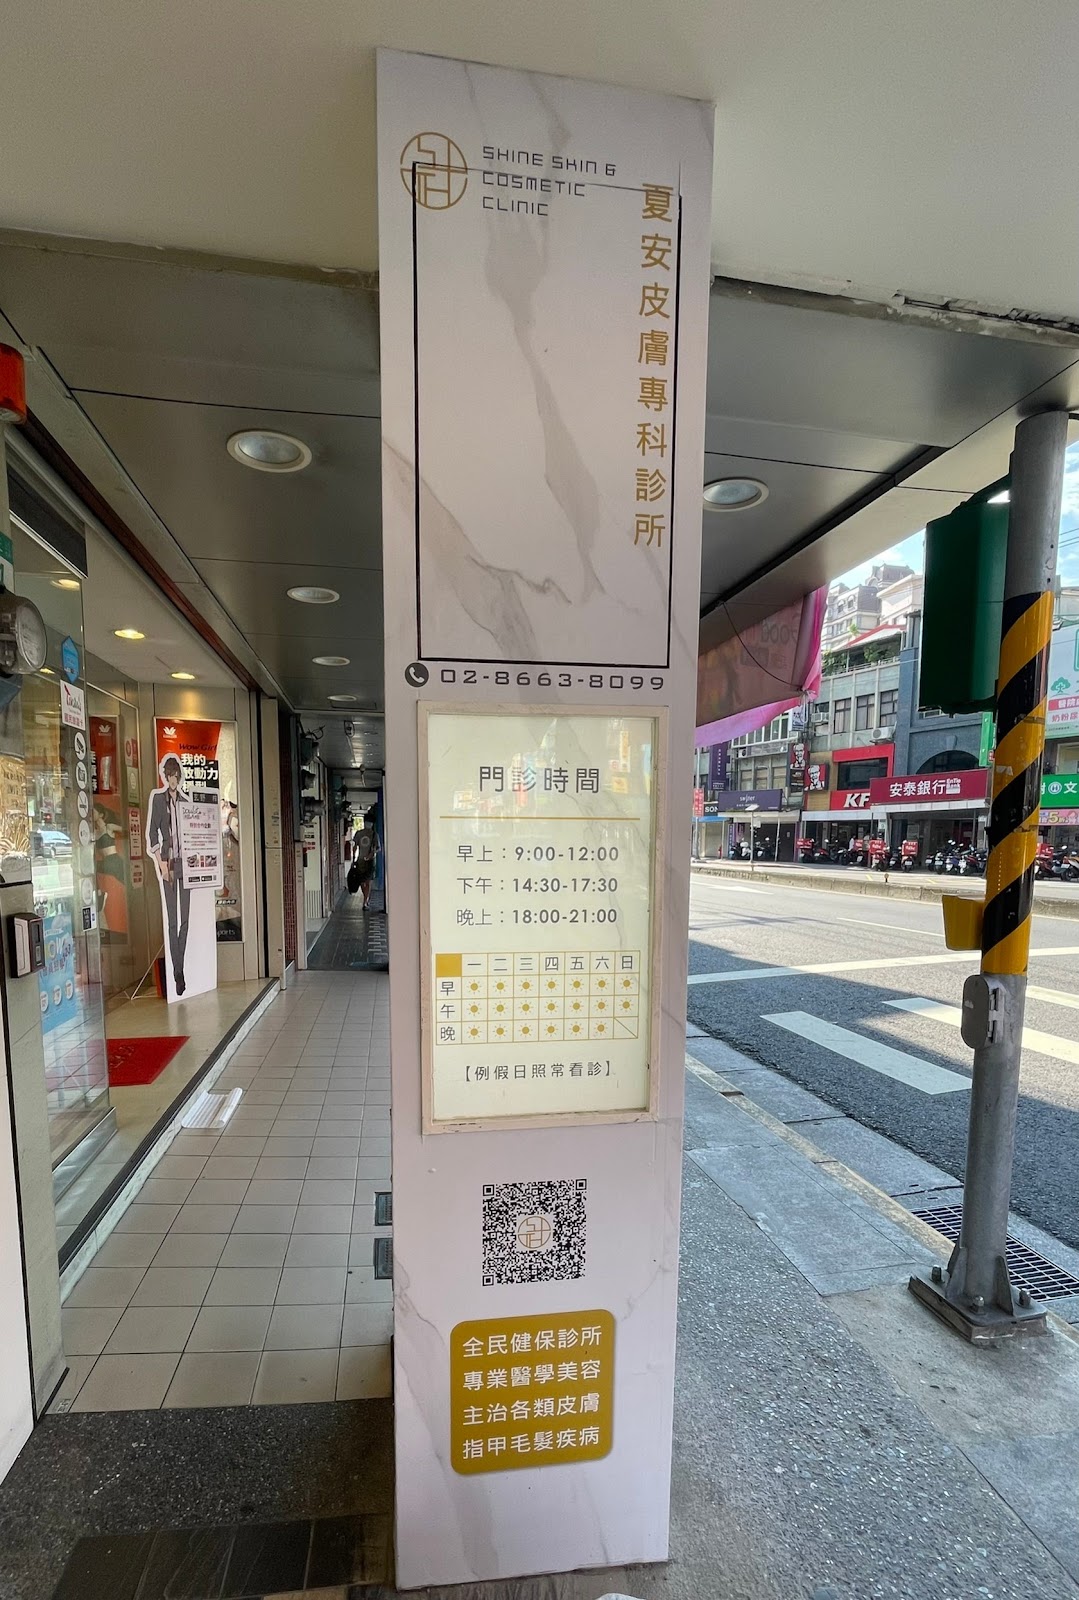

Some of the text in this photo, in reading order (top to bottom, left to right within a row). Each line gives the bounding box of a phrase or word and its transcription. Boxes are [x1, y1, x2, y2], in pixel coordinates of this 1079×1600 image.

[482, 145, 544, 167] SHINE
[551, 155, 597, 175] SKIN
[482, 170, 586, 197] COSMETIC
[482, 196, 549, 217] CLINIC
[632, 182, 675, 549] 夏安皮膚專科診所
[440, 668, 665, 691] 02-8663-8099
[180, 752, 207, 766] 我的
[478, 765, 600, 794] 門診時間
[889, 779, 946, 798] 安泰銀行
[843, 792, 871, 808] KF
[440, 981, 456, 996] 早
[440, 1004, 456, 1019] 午
[440, 1026, 456, 1042] 晚
[462, 1325, 603, 1358] 全民健保診所
[462, 1359, 601, 1392] 專業醫學美容
[462, 1392, 600, 1426] 主治各類皮膚
[462, 1426, 600, 1460] 指甲毛髮疾病
